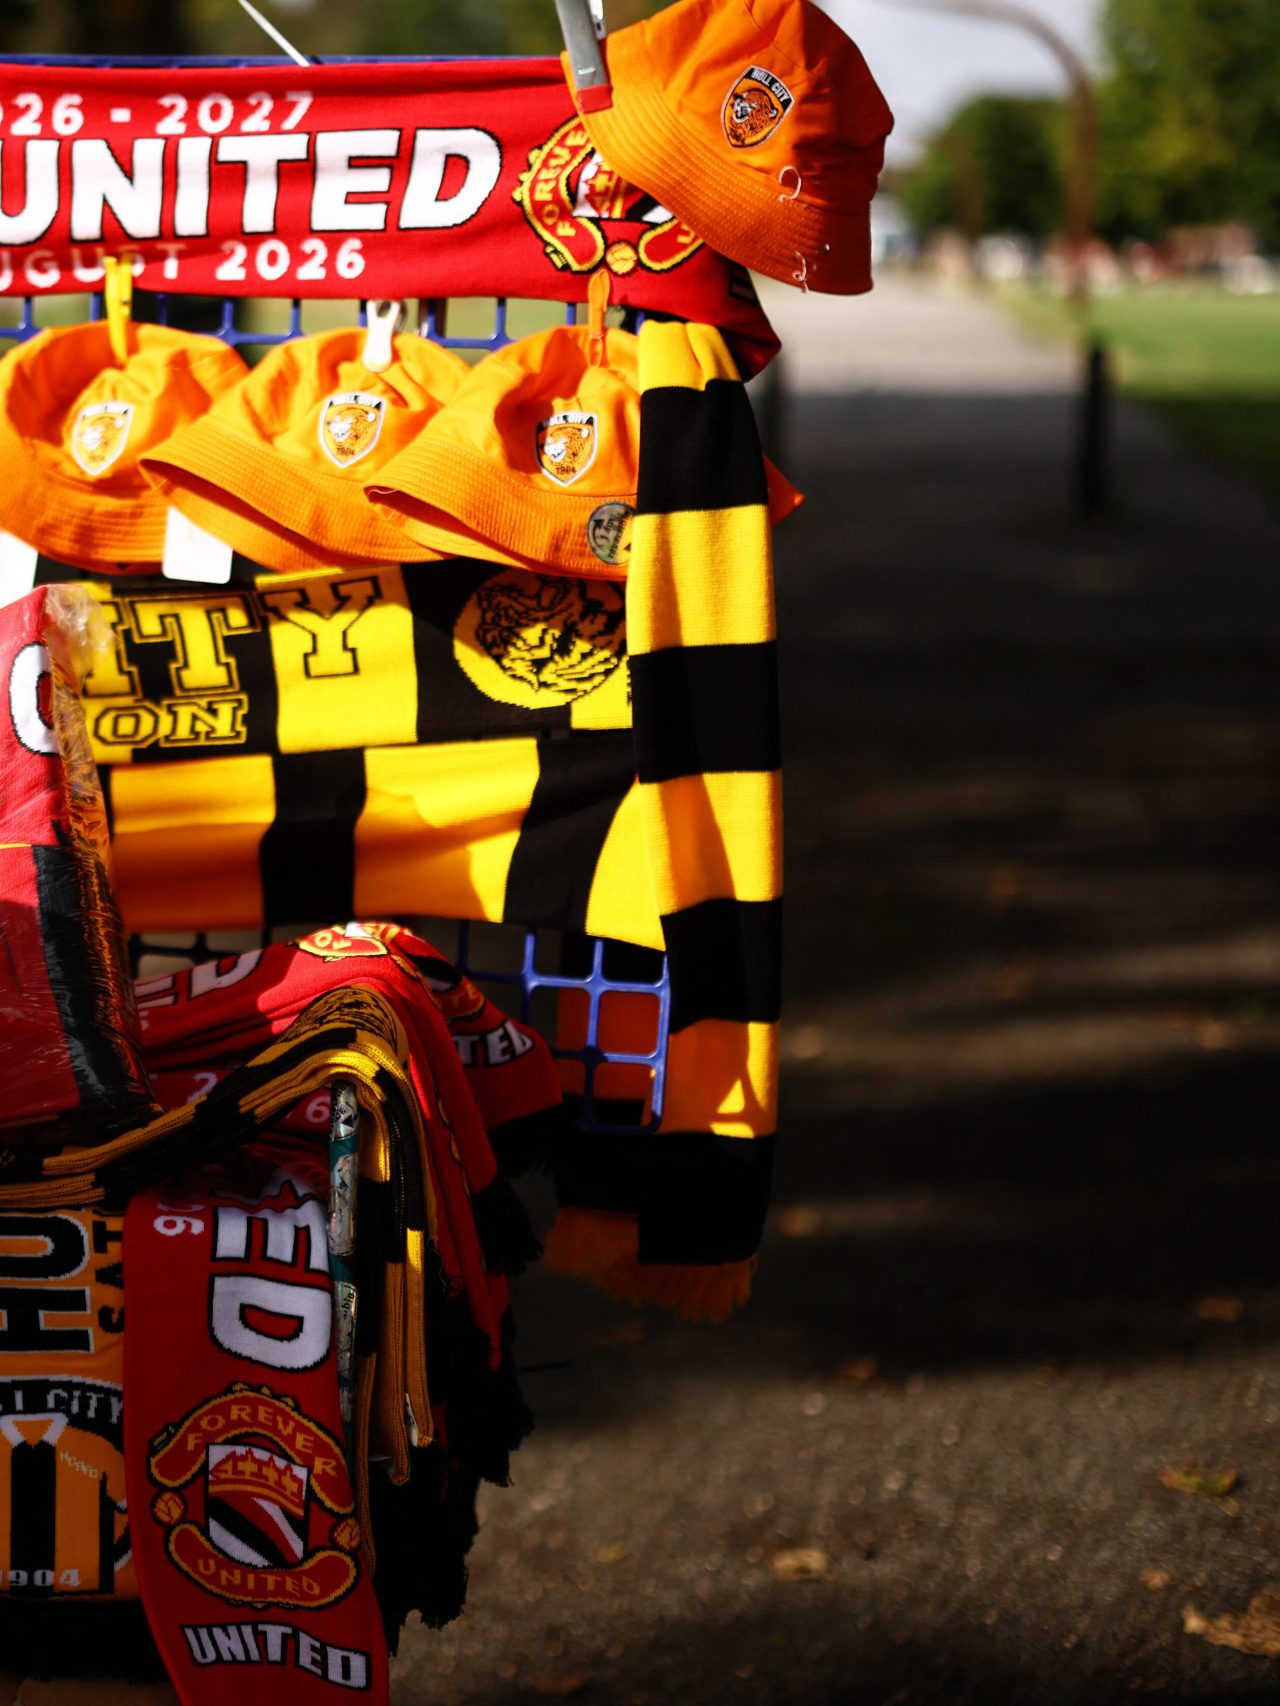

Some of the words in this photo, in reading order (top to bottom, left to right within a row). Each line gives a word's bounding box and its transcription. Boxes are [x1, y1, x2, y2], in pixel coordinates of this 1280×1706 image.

[157, 90, 314, 136] 2027
[534, 128, 589, 237] FOREVE
[216, 238, 366, 281] 2026
[83, 576, 383, 700] ITY
[186, 1404, 338, 1478] FOREVER
[195, 1555, 321, 1598] UNITED
[181, 1622, 372, 1691] UNITED
